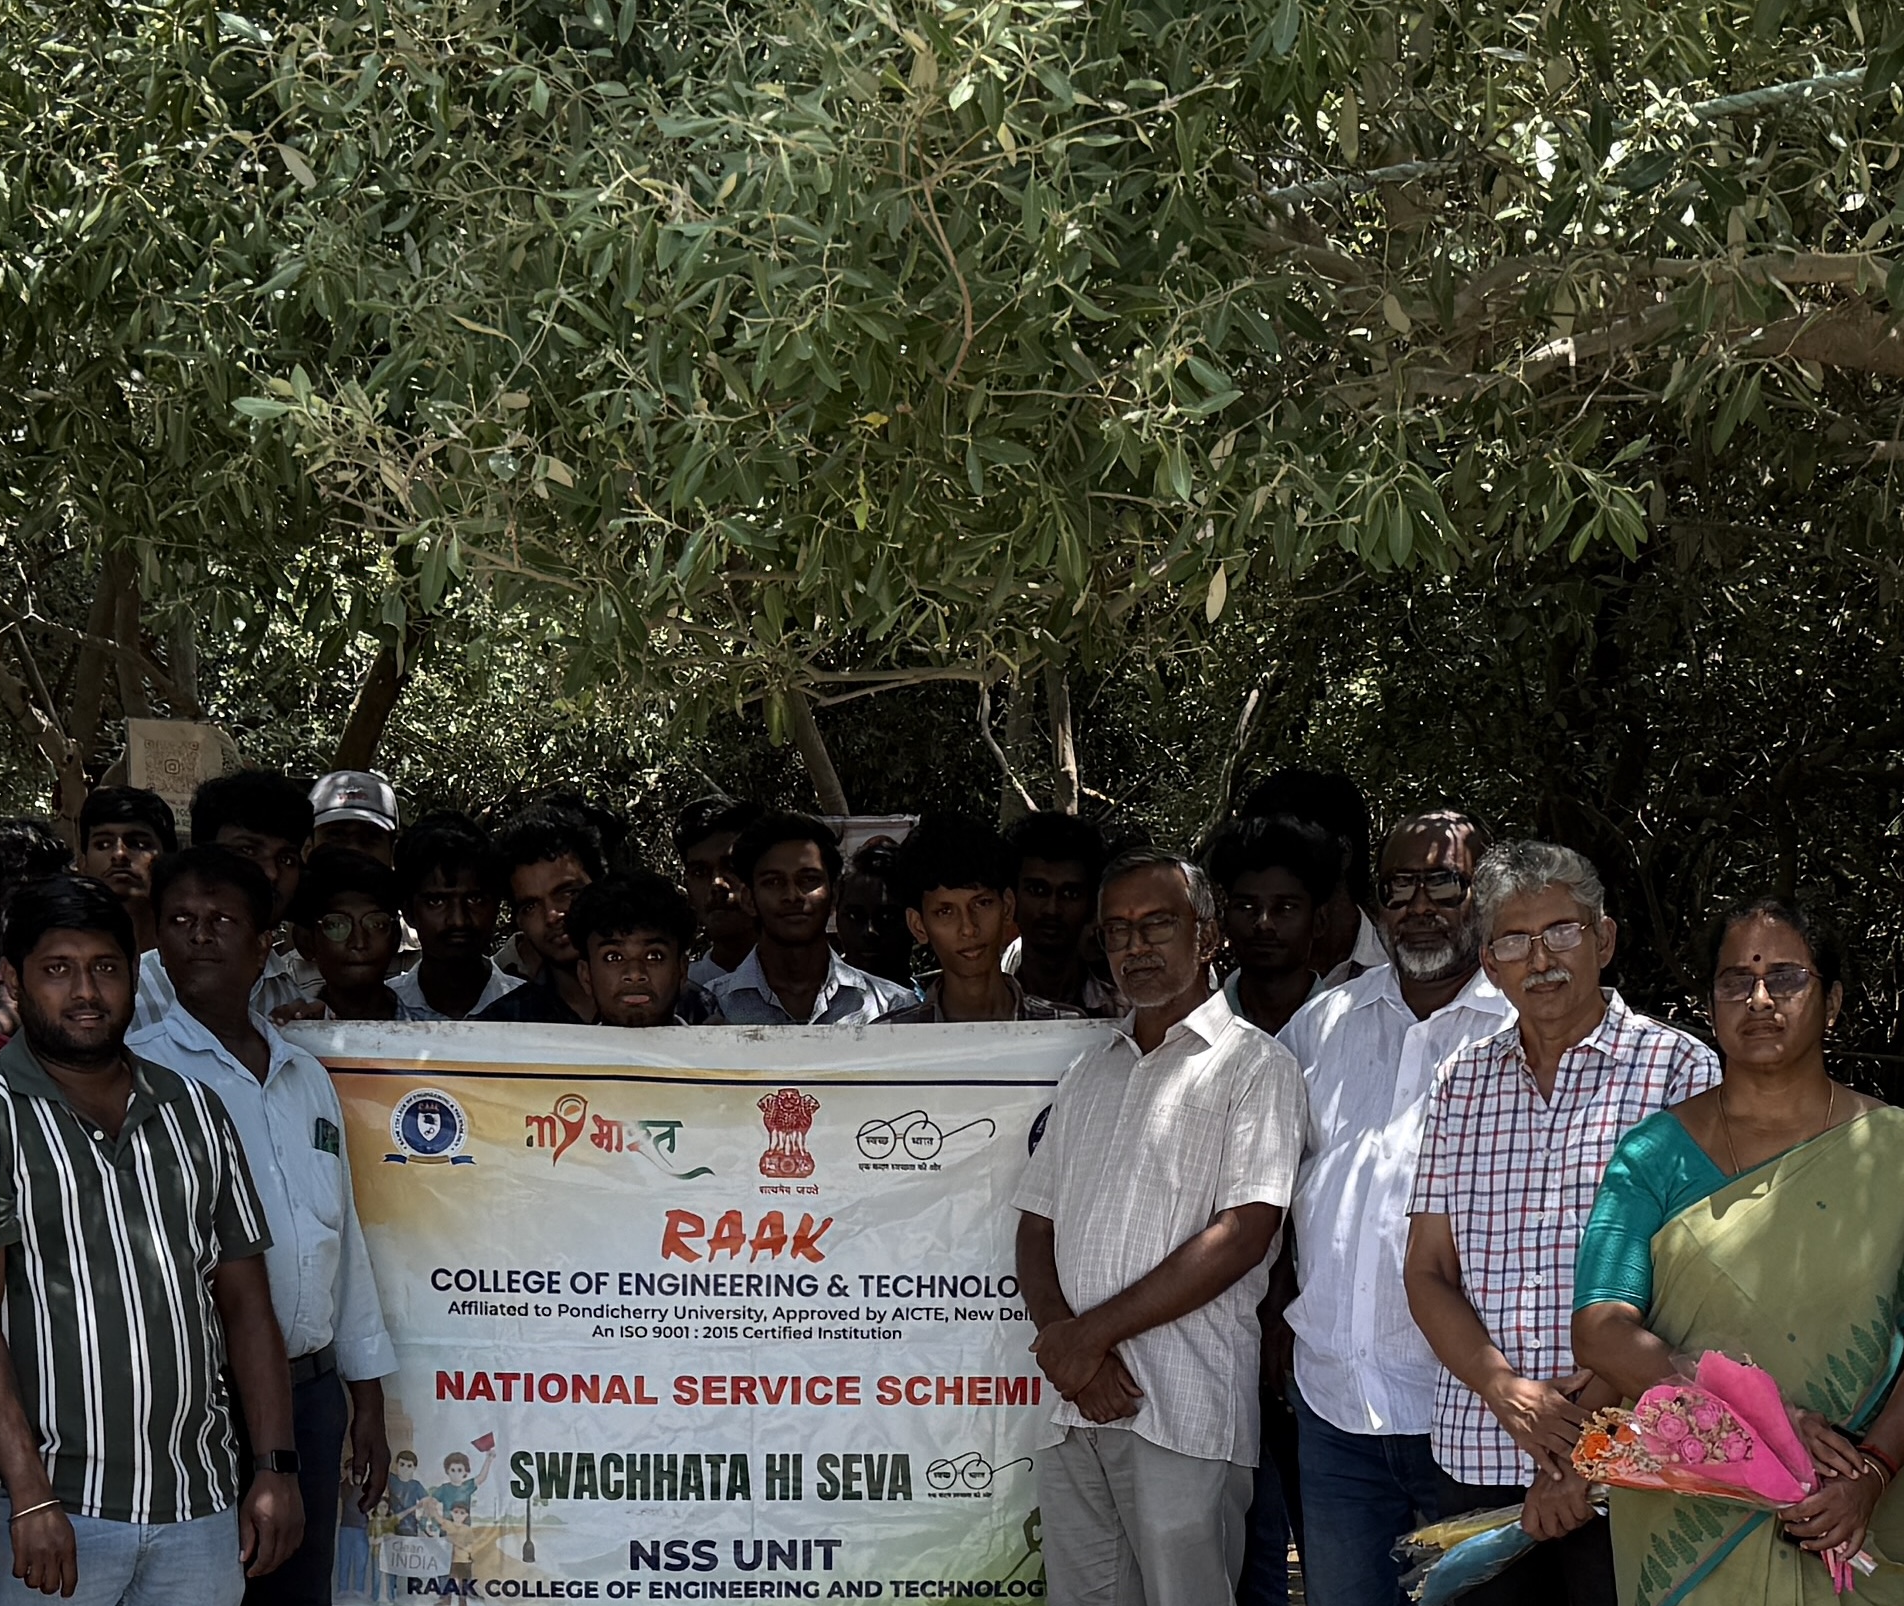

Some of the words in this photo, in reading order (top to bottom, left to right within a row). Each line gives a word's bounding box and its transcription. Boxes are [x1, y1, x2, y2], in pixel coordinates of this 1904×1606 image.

[661, 1208, 834, 1263] RAAK
[430, 1268, 561, 1294] COLLEGE
[569, 1271, 609, 1295] OF
[619, 1273, 819, 1297] ENGINEERING
[827, 1274, 850, 1298] &
[448, 1301, 528, 1317] Affiliated
[534, 1304, 552, 1317] to
[558, 1303, 668, 1322] Pondicherry
[674, 1305, 767, 1322] University,
[772, 1306, 860, 1323] Approved
[865, 1306, 887, 1323] by
[892, 1307, 948, 1323] AICTE,
[954, 1307, 994, 1321] New
[592, 1325, 614, 1338] An
[620, 1325, 647, 1338] ISO
[652, 1325, 689, 1339] 9001
[703, 1326, 738, 1339] 2015
[743, 1326, 813, 1340] Certified
[818, 1326, 902, 1340] Institution
[435, 1370, 658, 1405] NATIONAL
[673, 1375, 861, 1406] SERVICE
[509, 1450, 751, 1501] SWACHHATA
[766, 1453, 803, 1501] HI
[816, 1453, 913, 1501] SEVA
[392, 1541, 424, 1553] Clean
[629, 1540, 719, 1572] NSS
[733, 1539, 842, 1571] UNIT
[392, 1553, 438, 1570] INDIA
[407, 1577, 478, 1596] RAAK
[485, 1580, 599, 1599] COLLEGE
[607, 1581, 642, 1599] OF
[649, 1580, 820, 1599] ENGINEERING
[826, 1580, 883, 1598] AND
